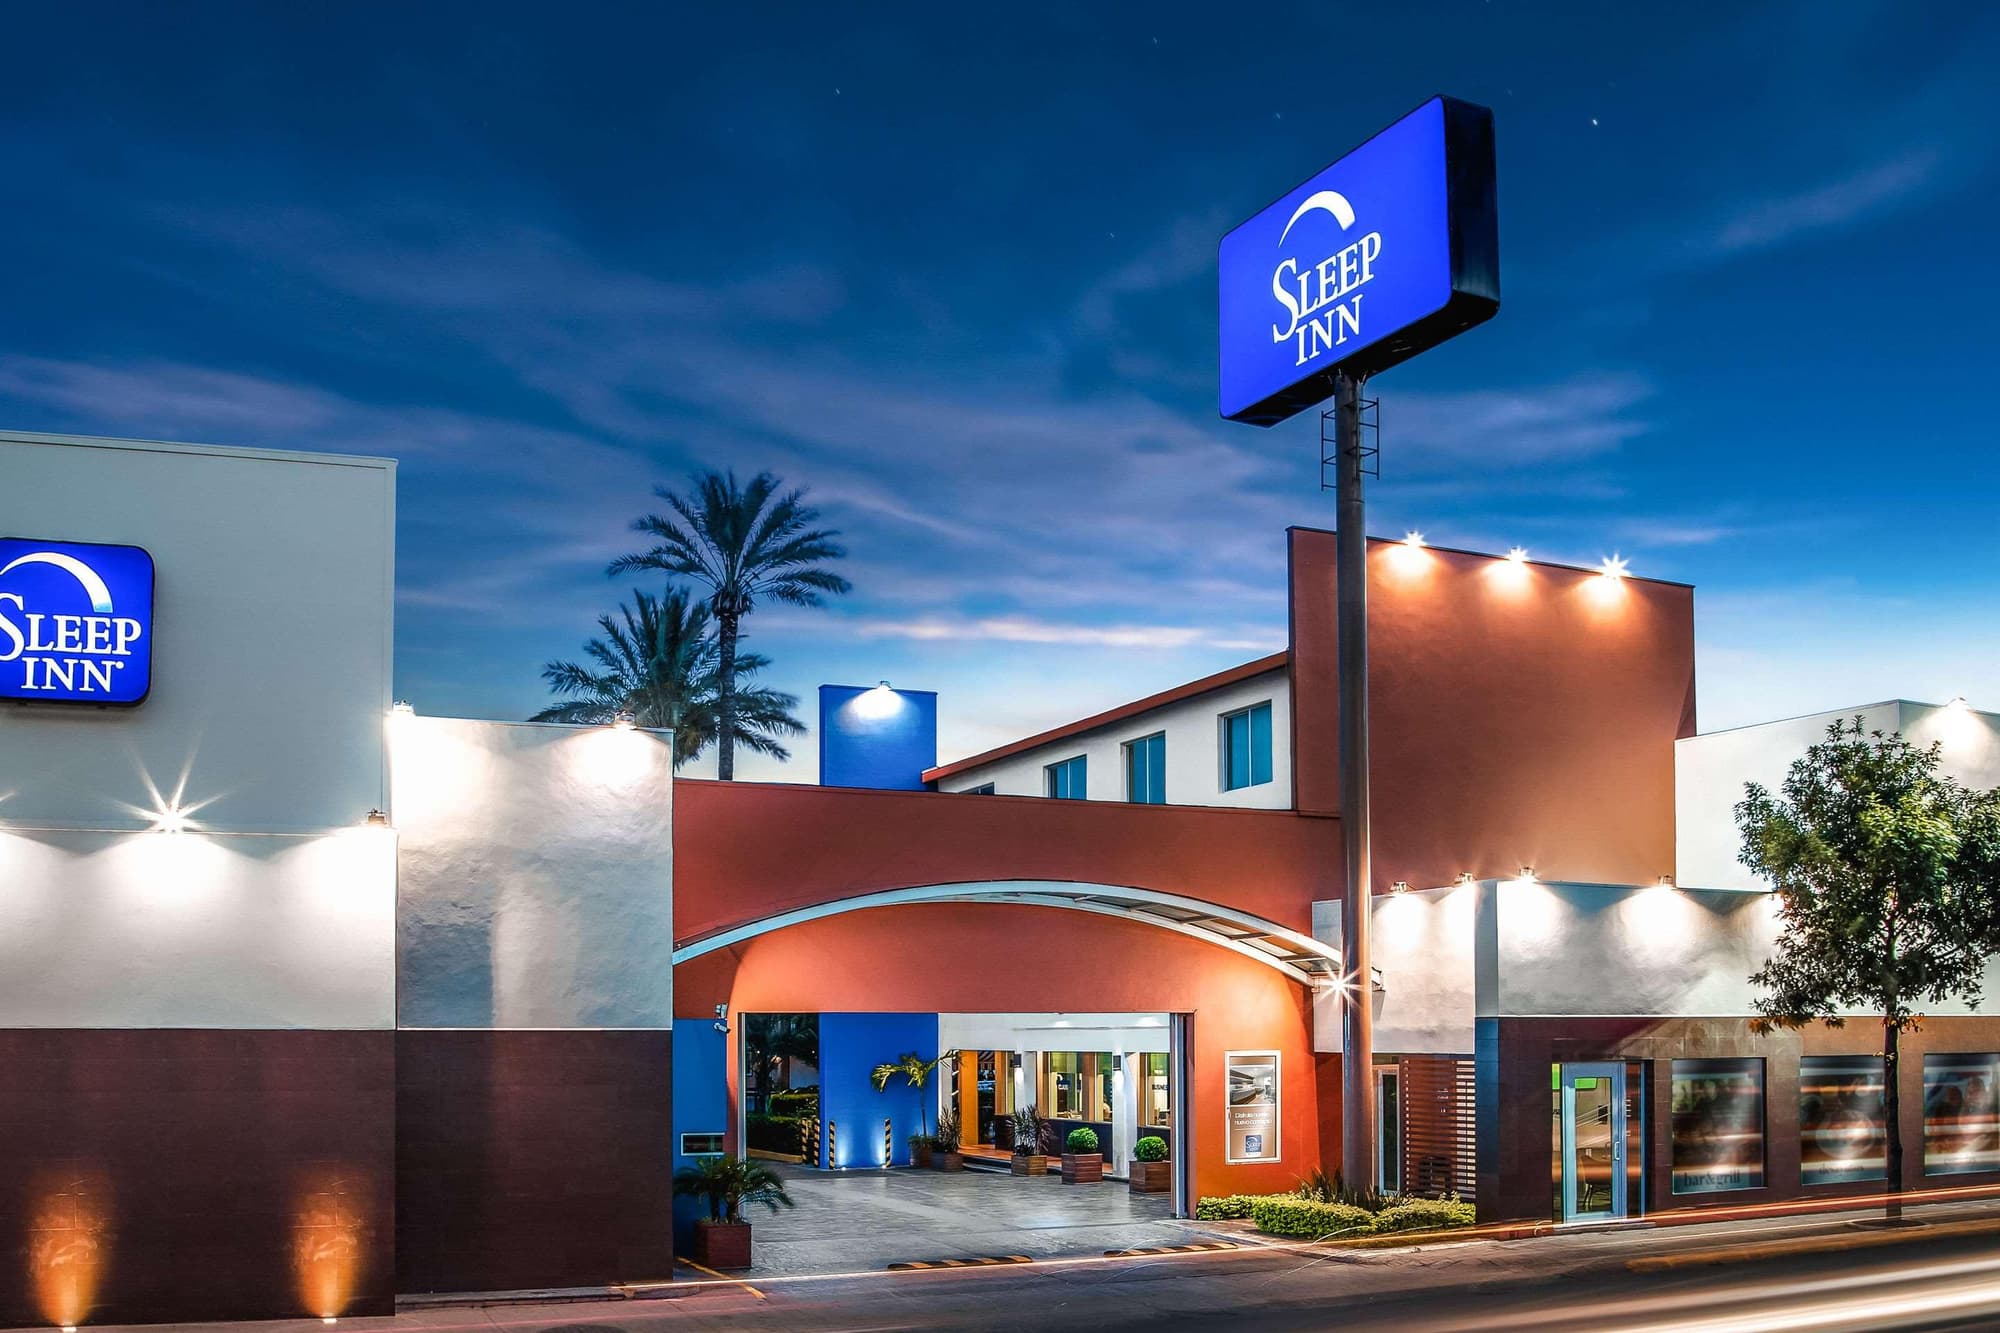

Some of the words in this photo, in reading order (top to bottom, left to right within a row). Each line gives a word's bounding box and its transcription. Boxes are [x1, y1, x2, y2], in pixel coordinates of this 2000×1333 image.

[1272, 231, 1382, 344] SLEEP
[1295, 294, 1363, 367] INN
[0, 592, 142, 661] SLEEP
